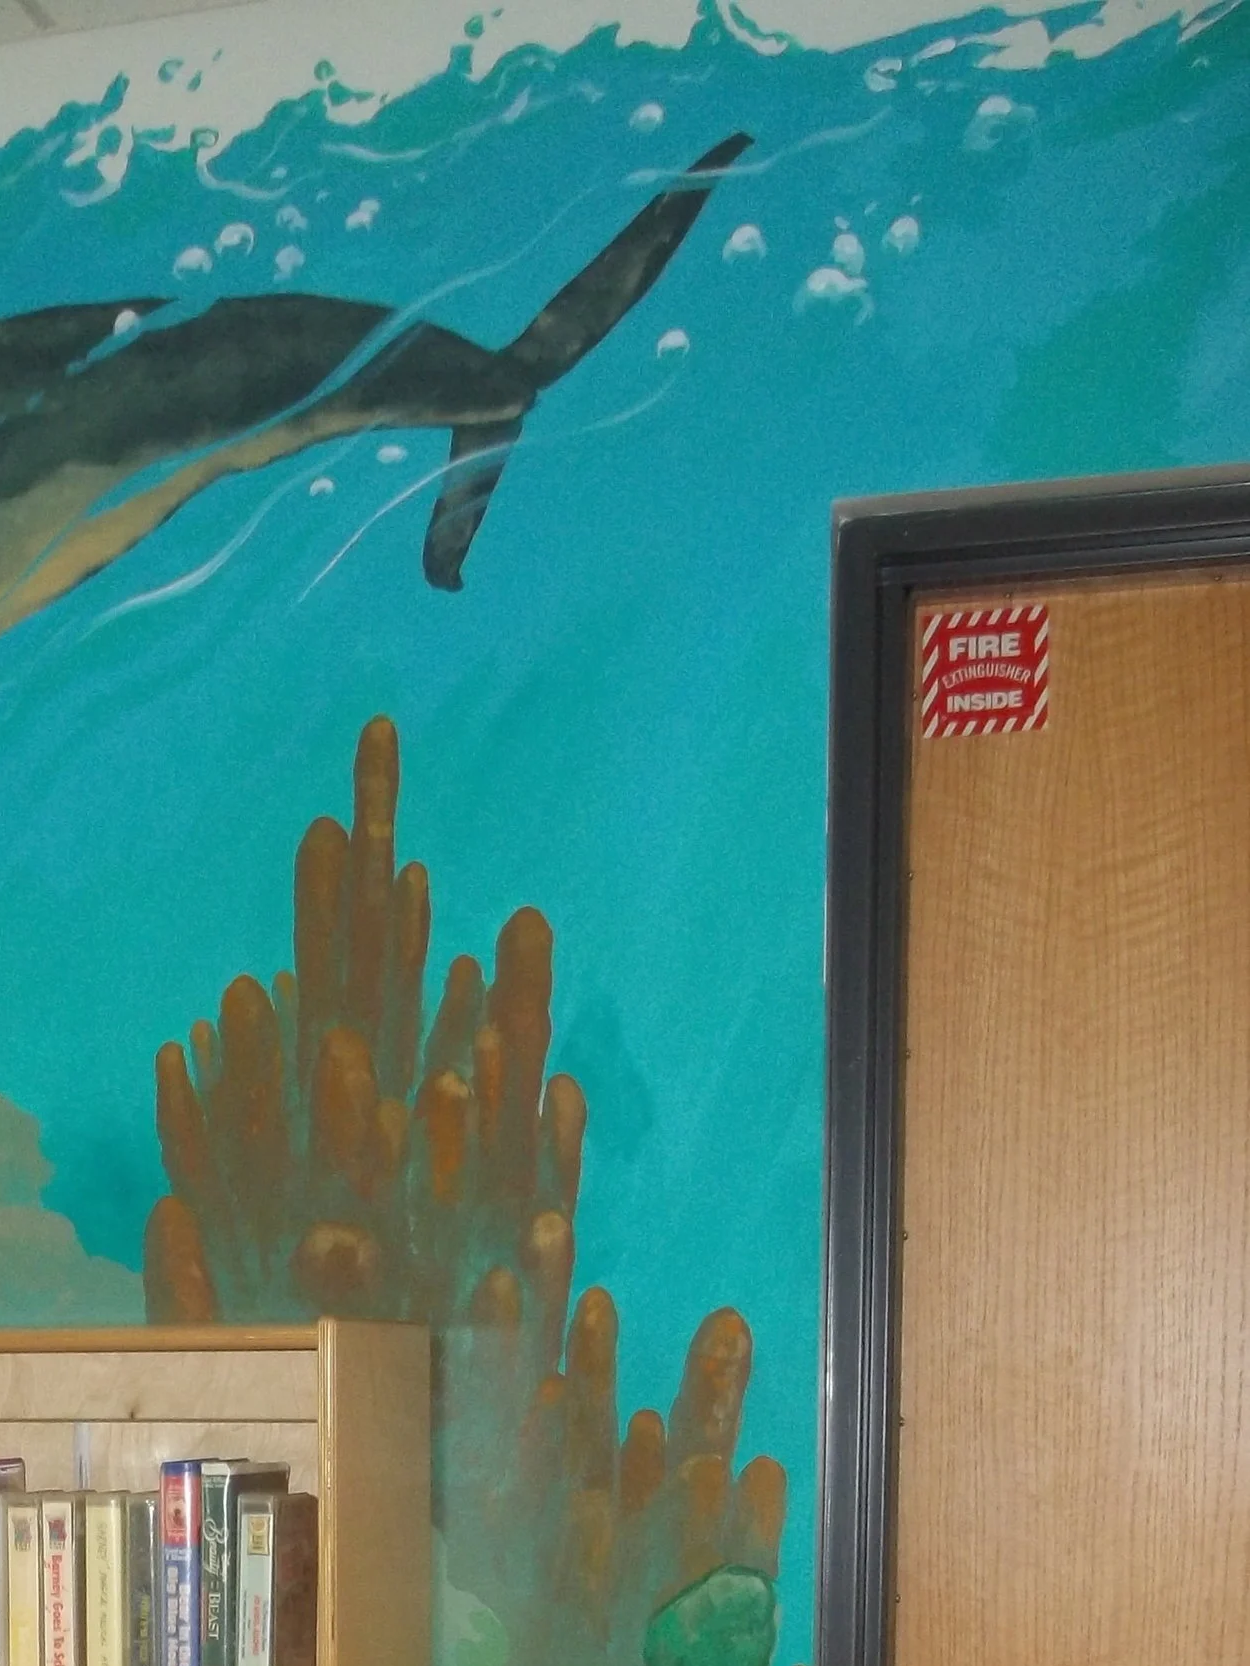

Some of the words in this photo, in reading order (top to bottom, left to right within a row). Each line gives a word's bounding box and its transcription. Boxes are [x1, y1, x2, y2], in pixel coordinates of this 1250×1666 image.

[948, 632, 1021, 661] FIRE
[941, 663, 1032, 689] EXTINGUISHER
[946, 690, 1023, 713] INSIDE
[203, 1519, 227, 1577] Beauty
[49, 1554, 65, 1598] Barney
[166, 1566, 179, 1594] Big
[52, 1602, 65, 1632] Goes
[167, 1598, 179, 1634] Blue
[178, 1584, 191, 1622] Bear
[207, 1592, 222, 1641] BEAST
[53, 1636, 65, 1649] To
[178, 1625, 191, 1642] in
